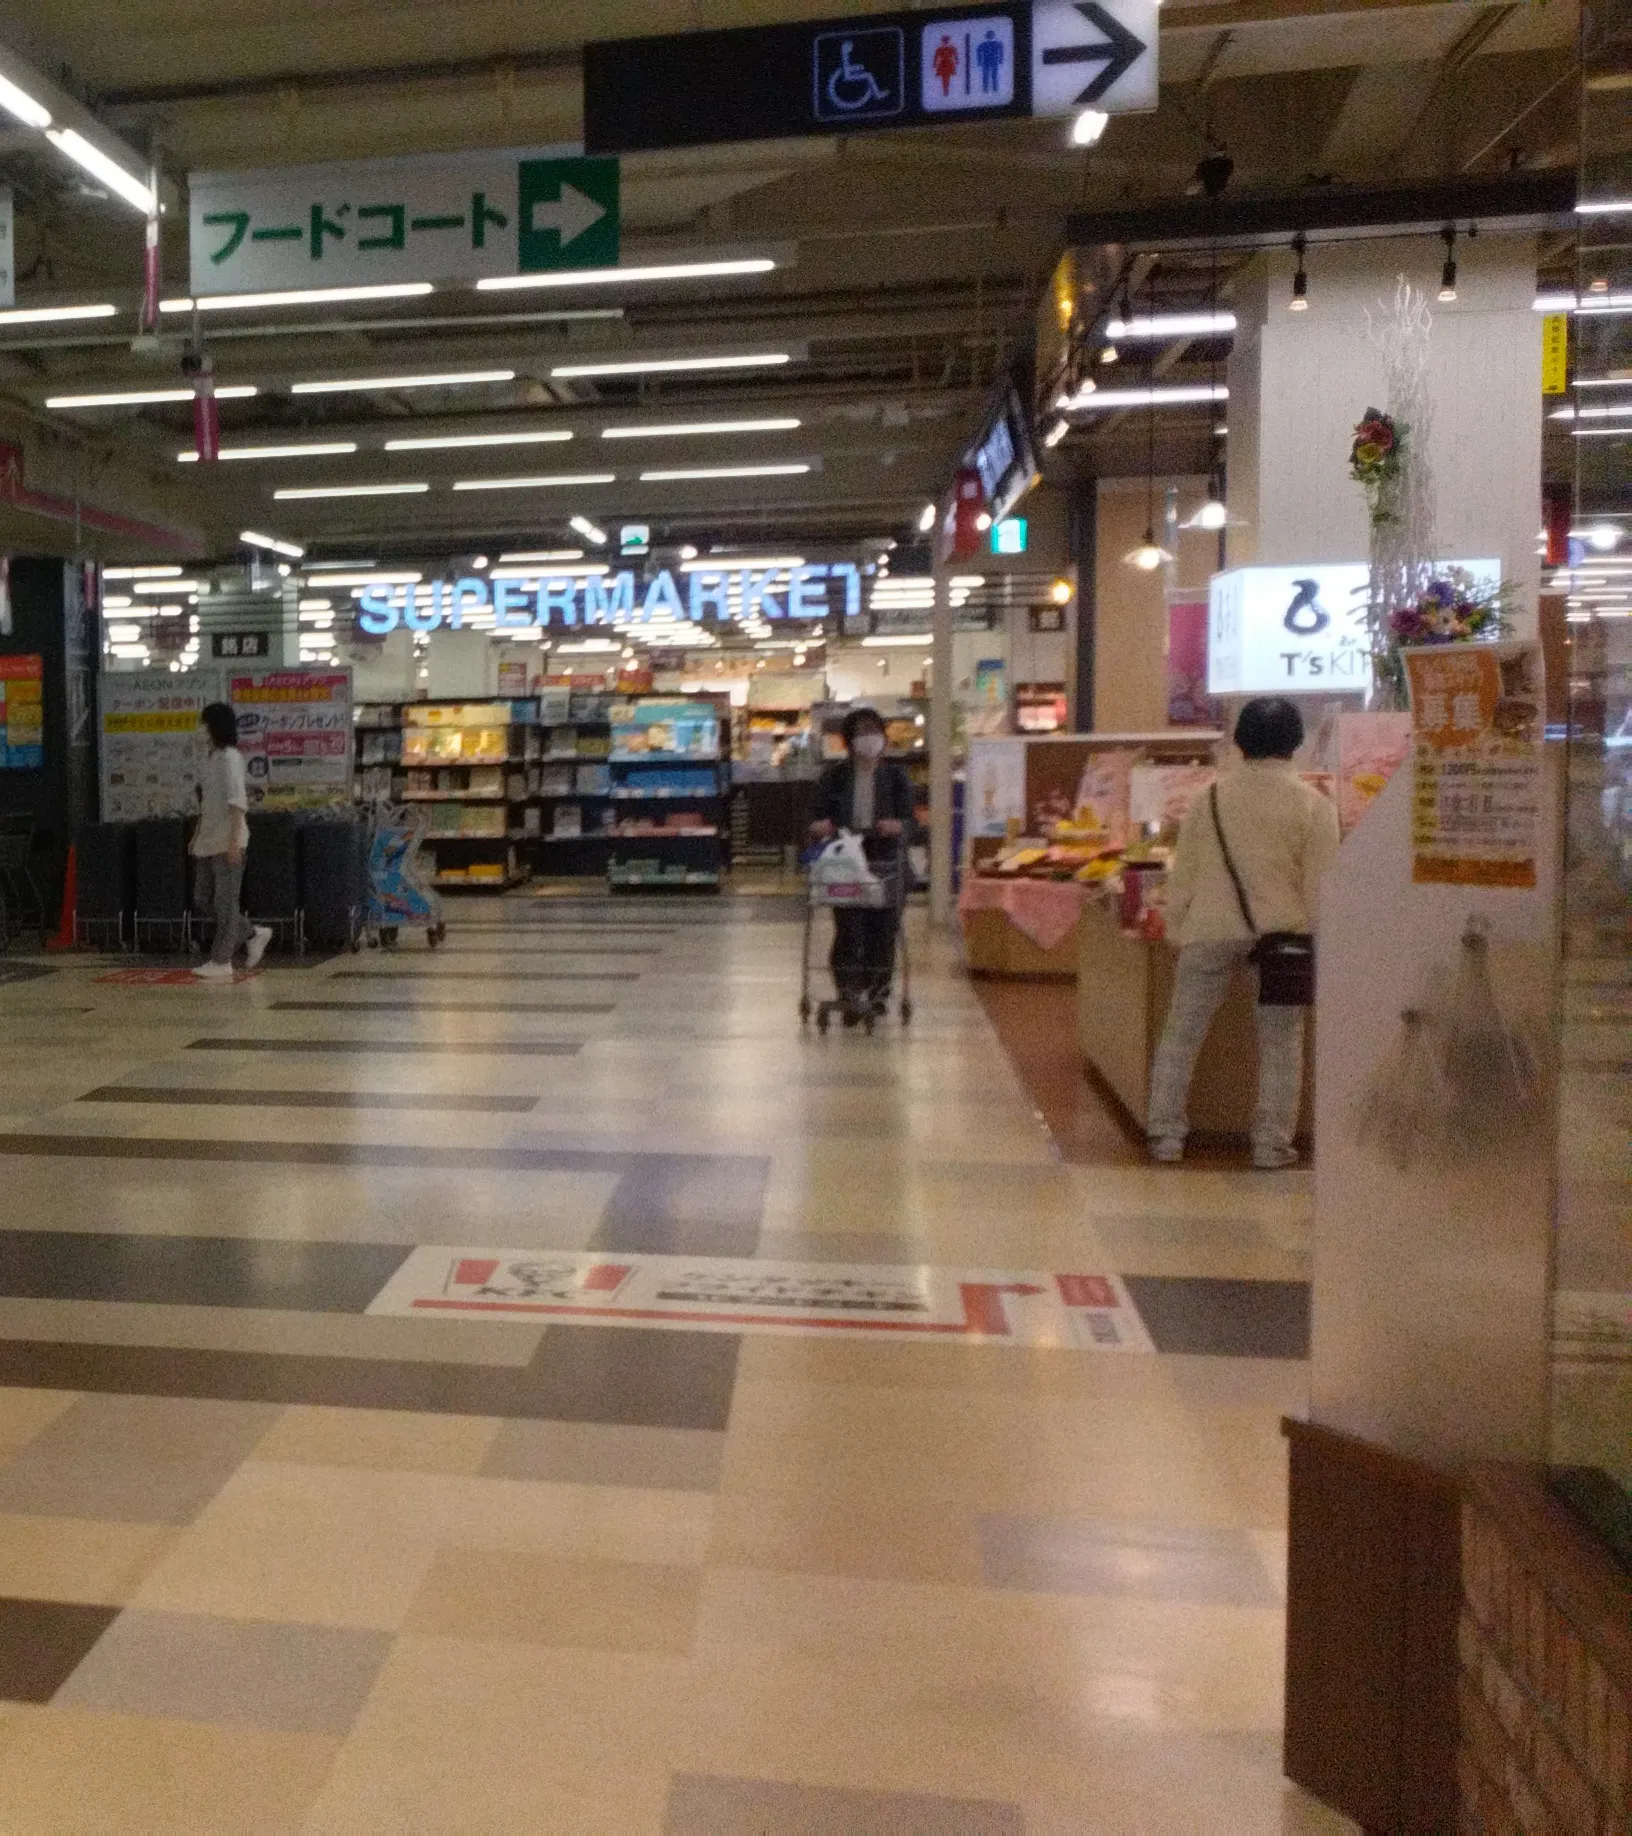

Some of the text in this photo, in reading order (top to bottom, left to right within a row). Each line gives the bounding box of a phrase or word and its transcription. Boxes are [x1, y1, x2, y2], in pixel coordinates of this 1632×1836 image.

[202, 192, 509, 266] フードコート
[358, 561, 876, 634] SUPERMARKET
